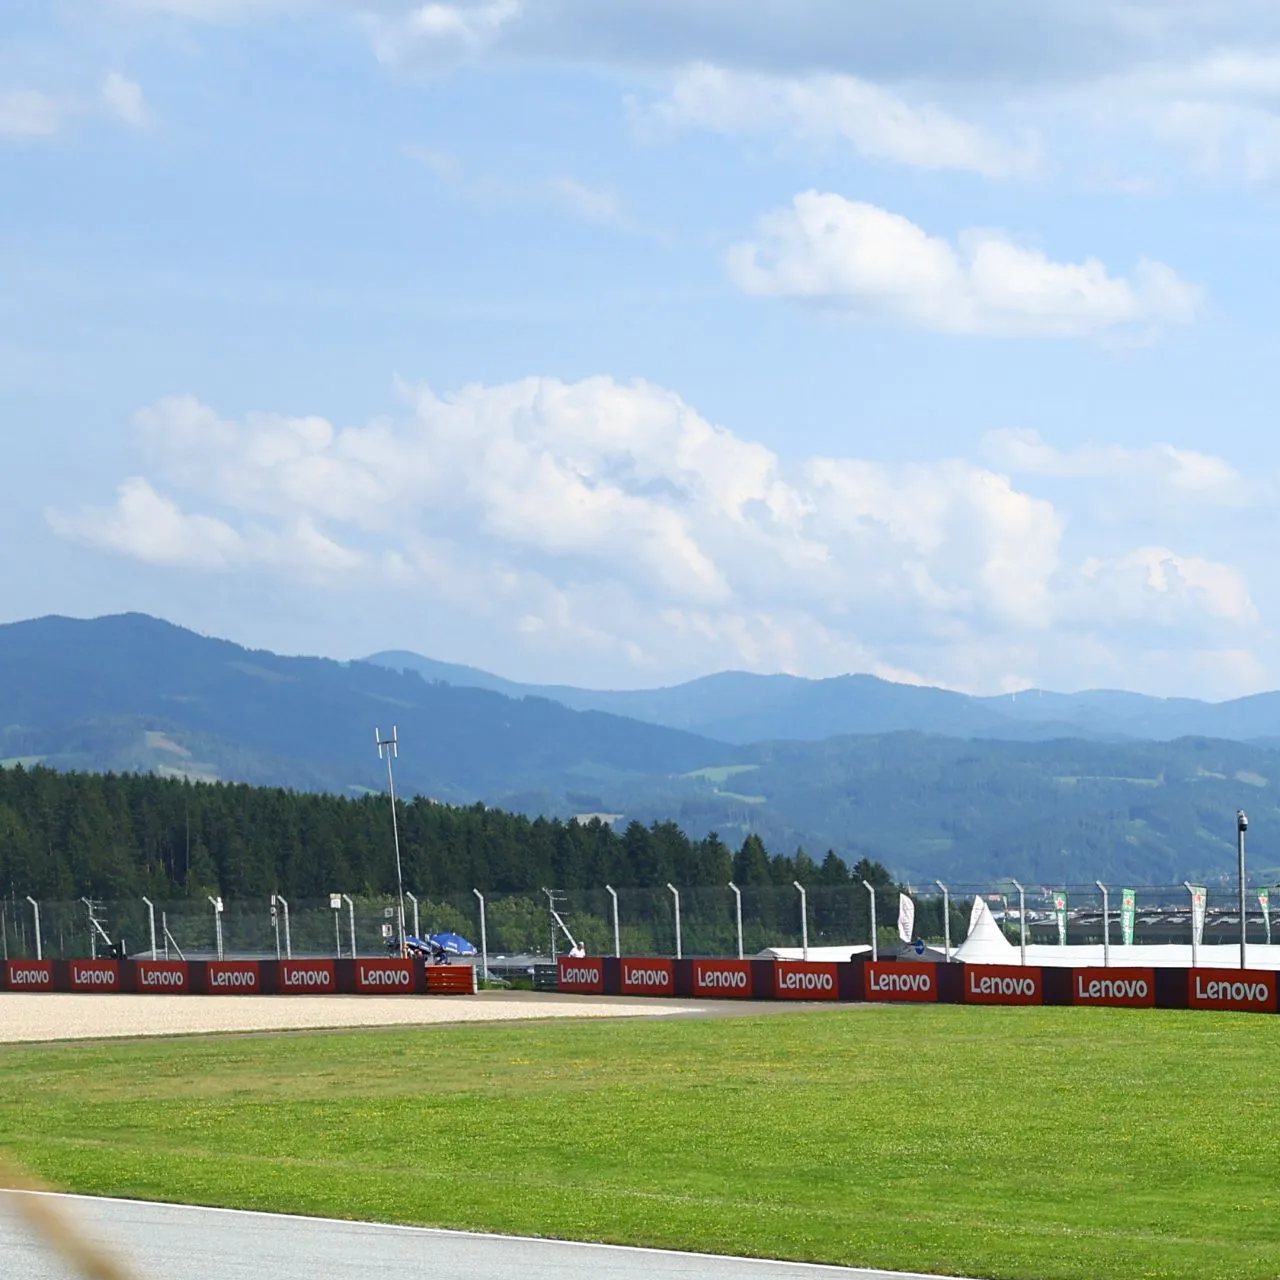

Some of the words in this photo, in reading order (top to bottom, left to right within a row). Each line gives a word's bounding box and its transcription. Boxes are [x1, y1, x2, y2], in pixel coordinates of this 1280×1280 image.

[11, 968, 49, 983] Lenovo
[75, 968, 114, 983] Lenovo
[141, 968, 183, 985] Lenovo
[211, 969, 254, 985] Lenovo
[285, 968, 329, 985] Lenovo
[361, 967, 409, 984] Lenovo
[561, 965, 598, 983] Lenovo
[625, 966, 668, 985] Lenovo
[698, 968, 746, 987] Lenovo
[779, 969, 832, 989] Lenovo
[871, 970, 930, 990] Lenovo
[971, 972, 1034, 995] Lenovo
[1079, 976, 1147, 997] Lenovo
[1197, 977, 1268, 1001] Lenovo
